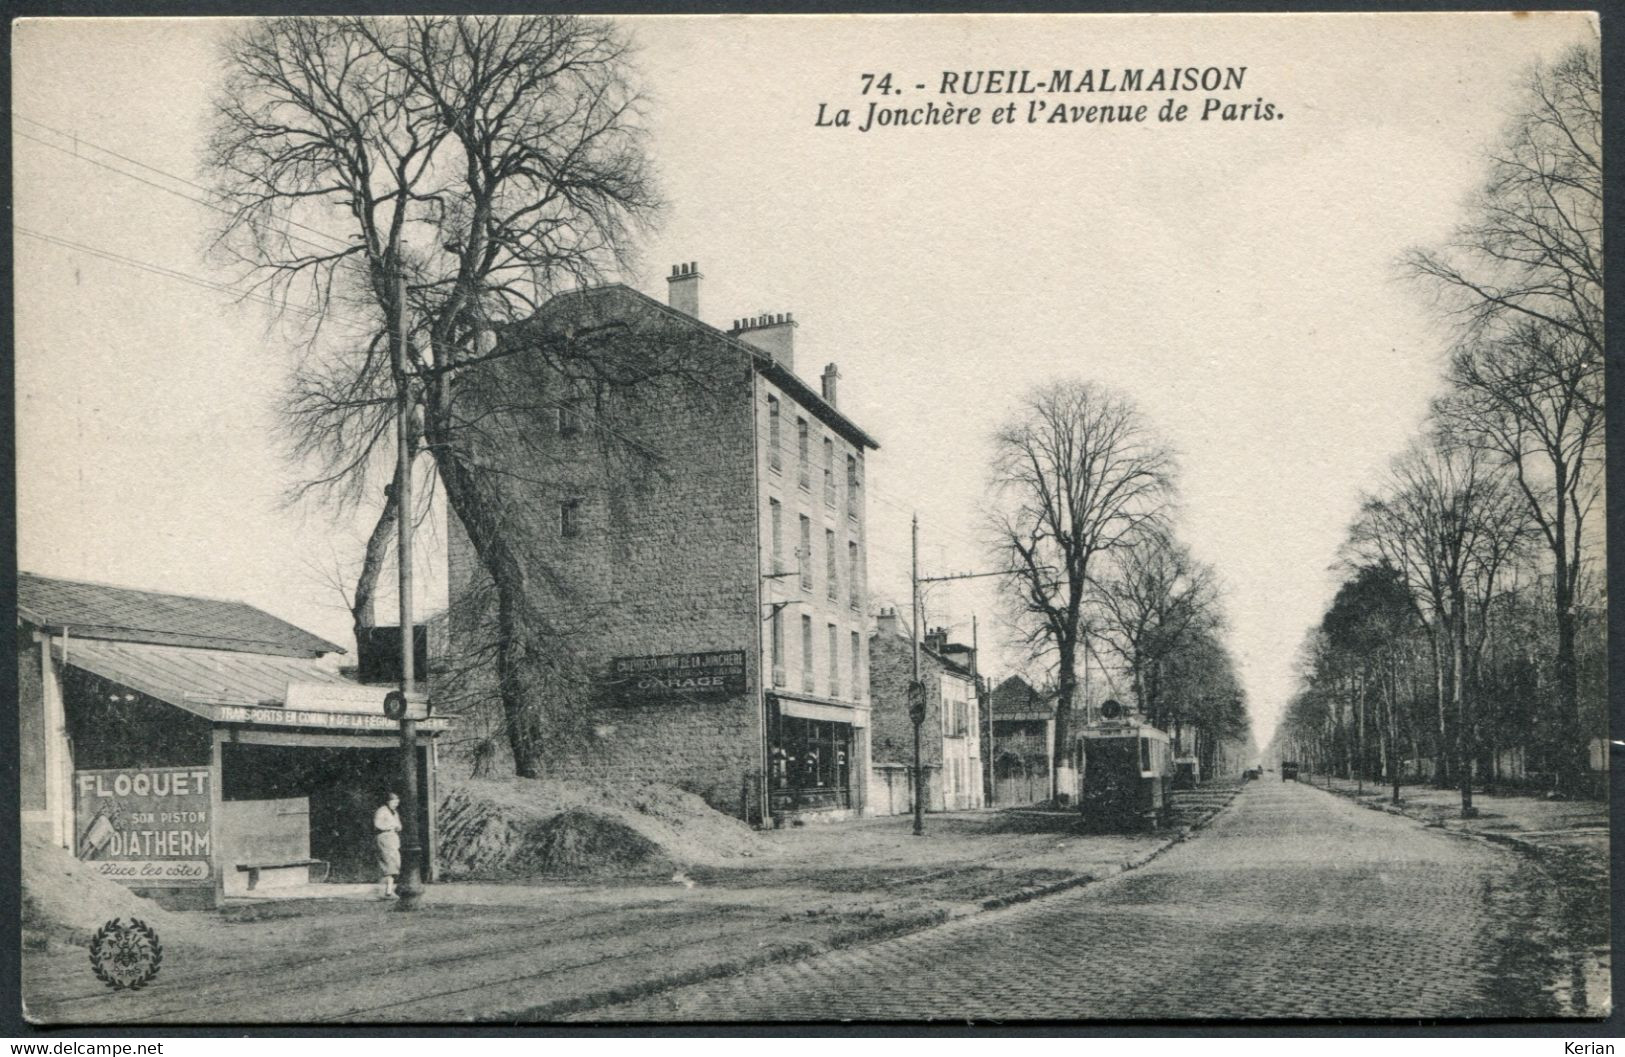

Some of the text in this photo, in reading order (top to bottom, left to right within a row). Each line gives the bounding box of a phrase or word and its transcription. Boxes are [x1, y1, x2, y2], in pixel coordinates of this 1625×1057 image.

[221, 706, 283, 722] TRANSPORTS
[80, 771, 209, 797] FLOQUET
[131, 811, 206, 824] SON PISTON
[110, 830, 210, 856] DIATHERM
[141, 862, 162, 876] les
[166, 864, 202, 876] côtes
